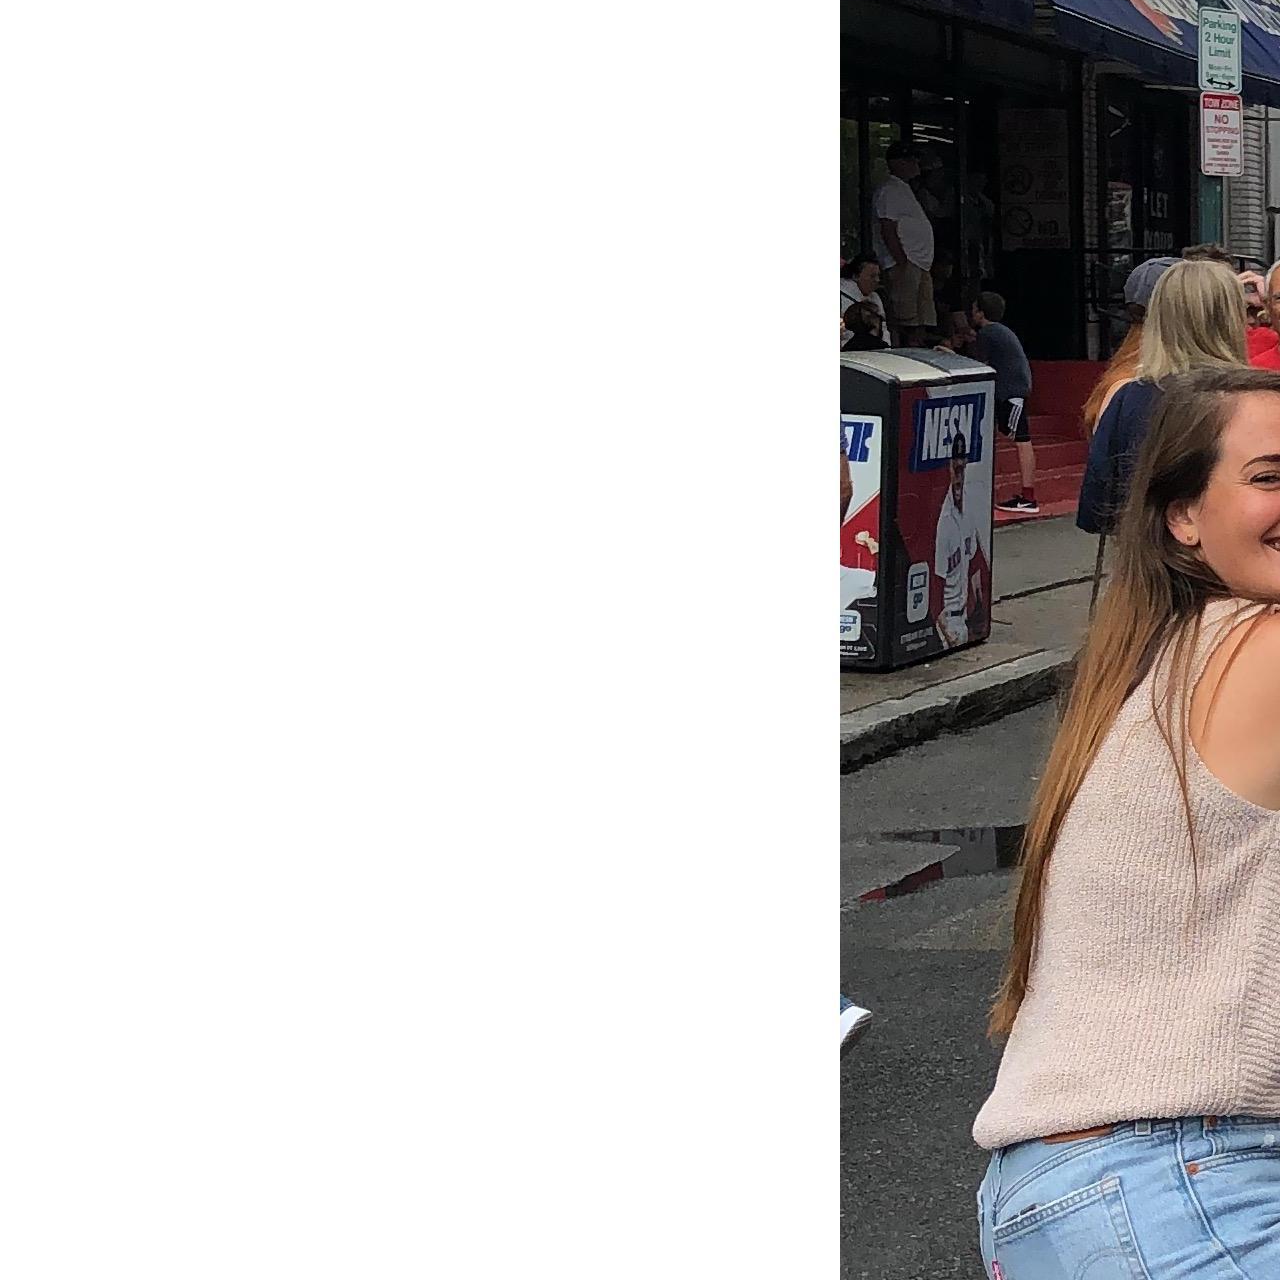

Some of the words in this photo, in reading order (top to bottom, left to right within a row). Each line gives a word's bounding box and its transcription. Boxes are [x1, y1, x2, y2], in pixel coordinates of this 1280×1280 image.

[1203, 17, 1236, 33] Parking
[1205, 31, 1211, 42] 2
[1214, 32, 1235, 44] Hour
[1209, 46, 1231, 58] Limit
[1214, 114, 1229, 124] NO
[921, 403, 974, 461] NESN
